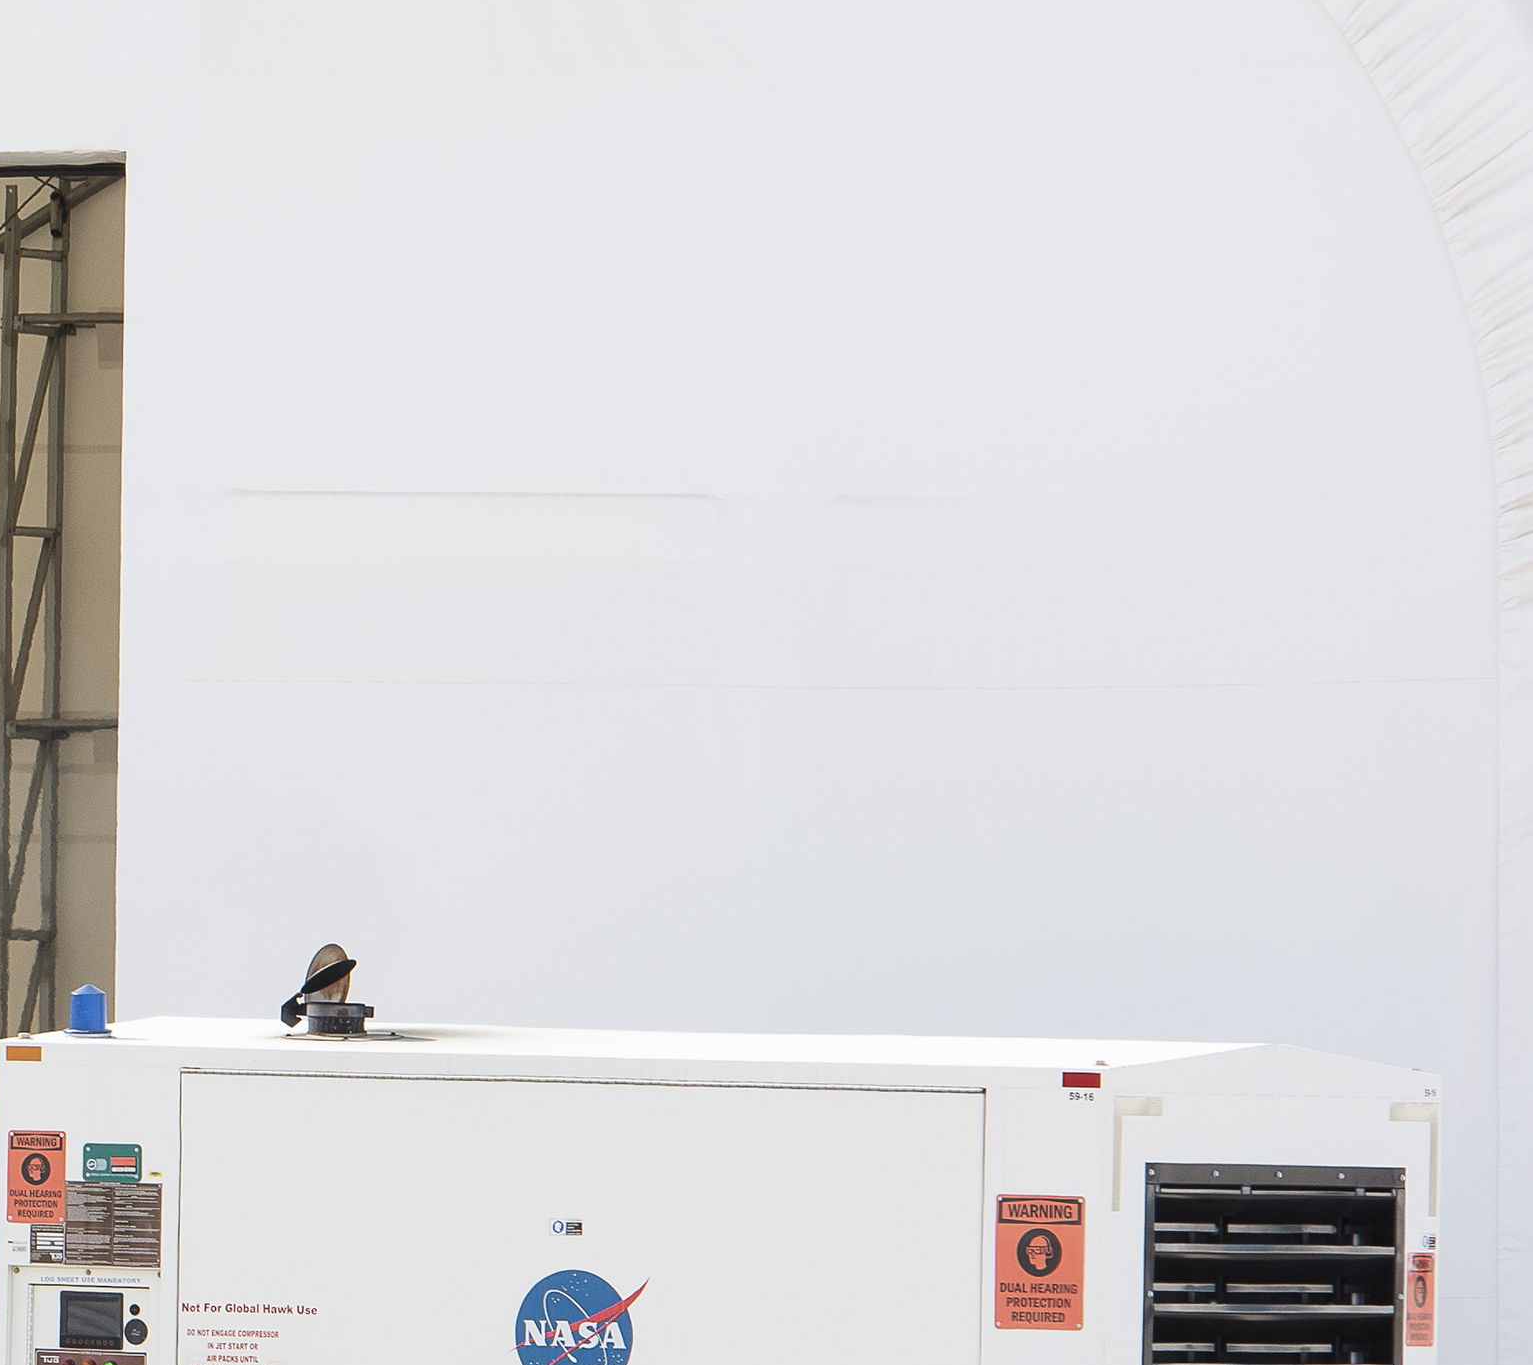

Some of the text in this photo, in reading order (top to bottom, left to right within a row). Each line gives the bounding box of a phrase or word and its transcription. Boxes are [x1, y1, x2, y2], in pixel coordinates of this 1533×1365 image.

[16, 1136, 57, 1147] WARNING
[9, 1189, 62, 1198] DUAL HEARING
[14, 1199, 58, 1208] PROTECTION
[17, 1210, 54, 1219] REQUIRED
[1007, 1204, 1072, 1219] WARNING
[1000, 1282, 1078, 1294] DUAL HEARING
[1006, 1297, 1071, 1308] PROTECTION
[181, 1303, 318, 1315] Not For Global Hawk Use
[1011, 1311, 1066, 1323] REQUIRED
[197, 1329, 210, 1337] NOT
[211, 1329, 236, 1337] ENGAGE
[237, 1330, 279, 1338] COMPRESSOR
[523, 1319, 627, 1350] NASA
[206, 1355, 217, 1363] AIR
[218, 1355, 239, 1363] PACKS
